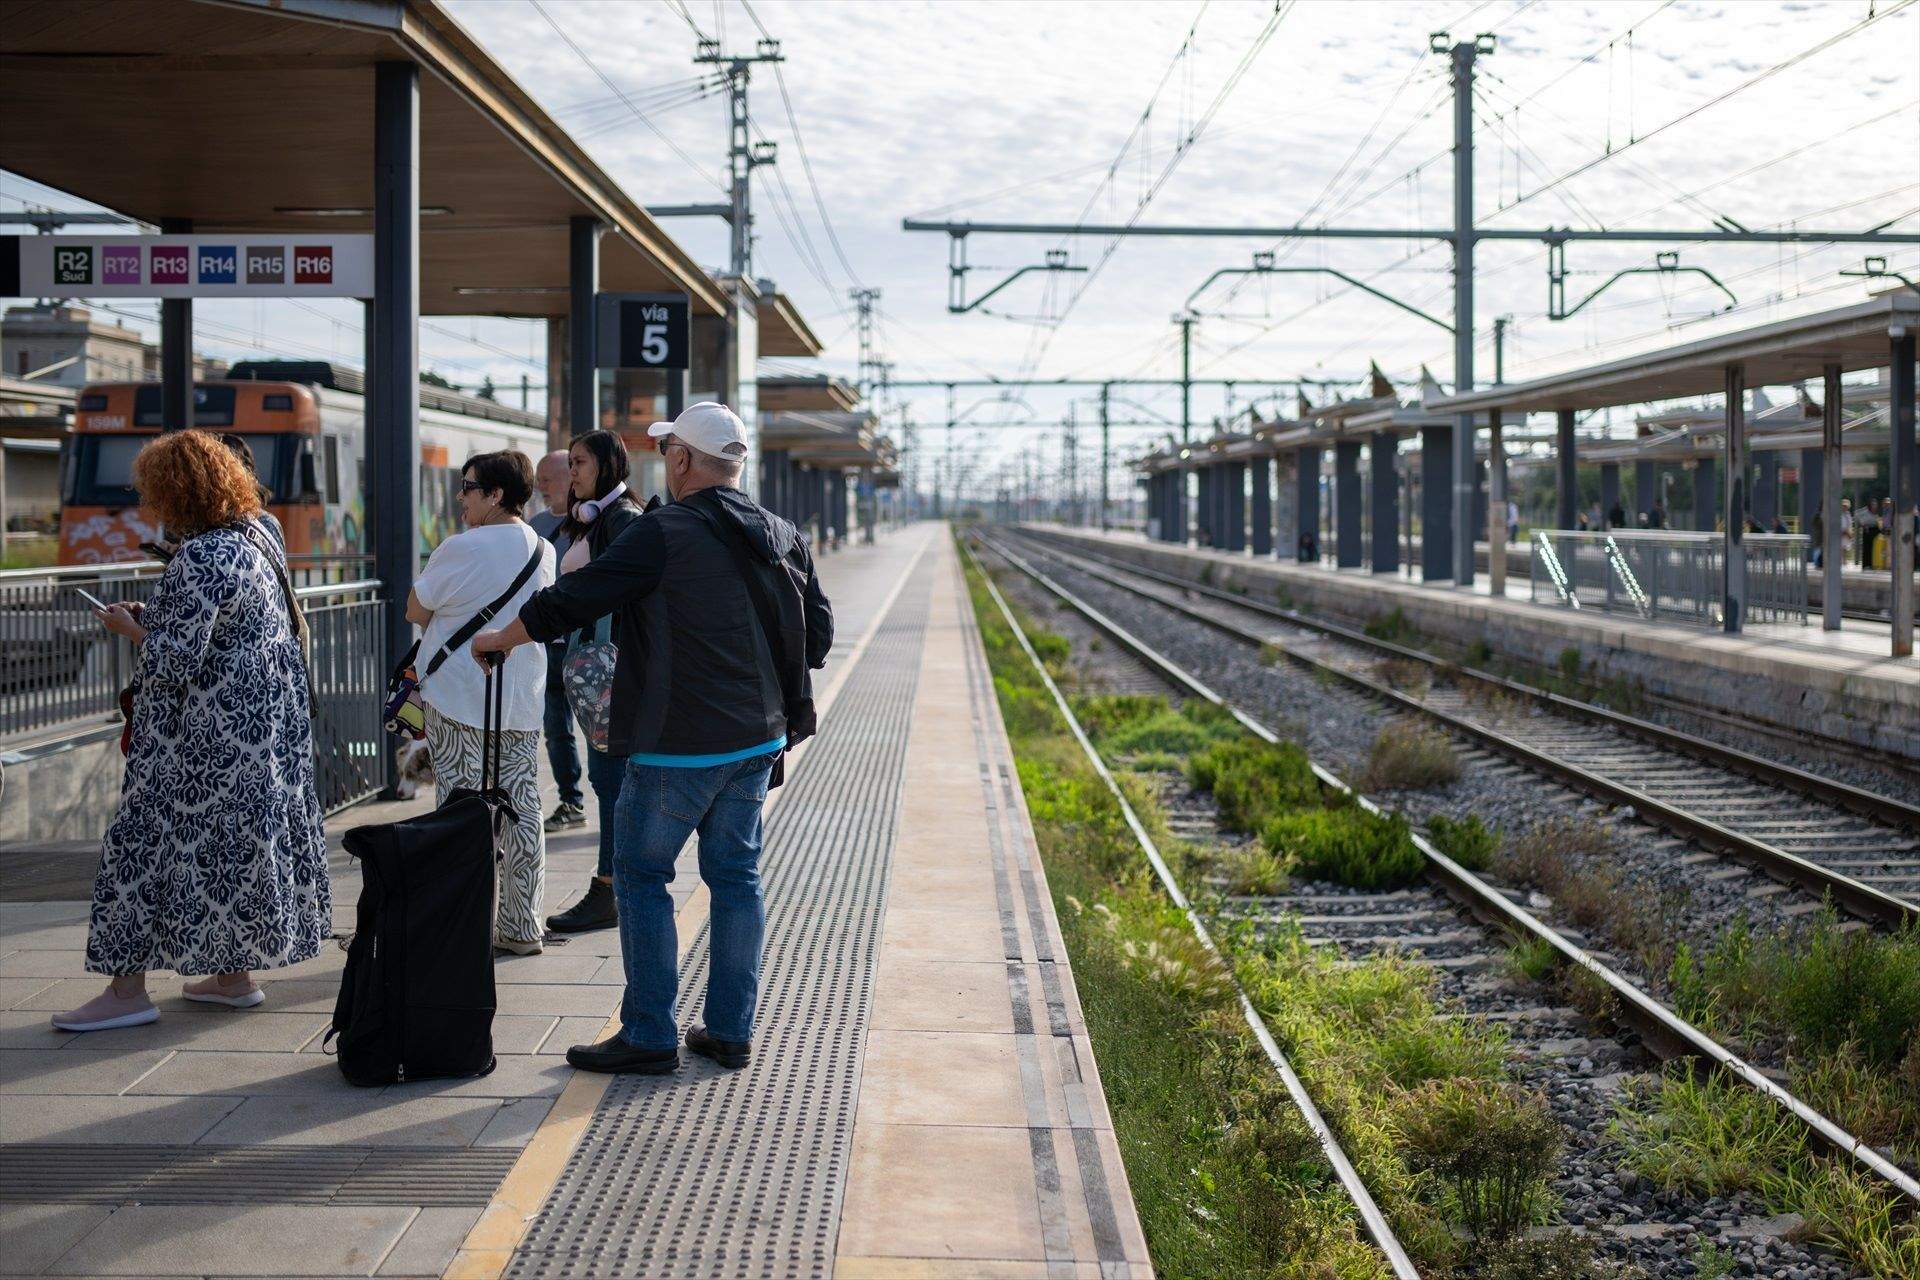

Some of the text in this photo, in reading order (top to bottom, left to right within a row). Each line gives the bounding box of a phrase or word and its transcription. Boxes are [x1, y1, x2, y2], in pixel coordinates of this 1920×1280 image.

[58, 251, 332, 274] R2 RT2 R13 R14 R15 R16
[62, 271, 85, 282] Sud
[641, 324, 669, 364] 5
